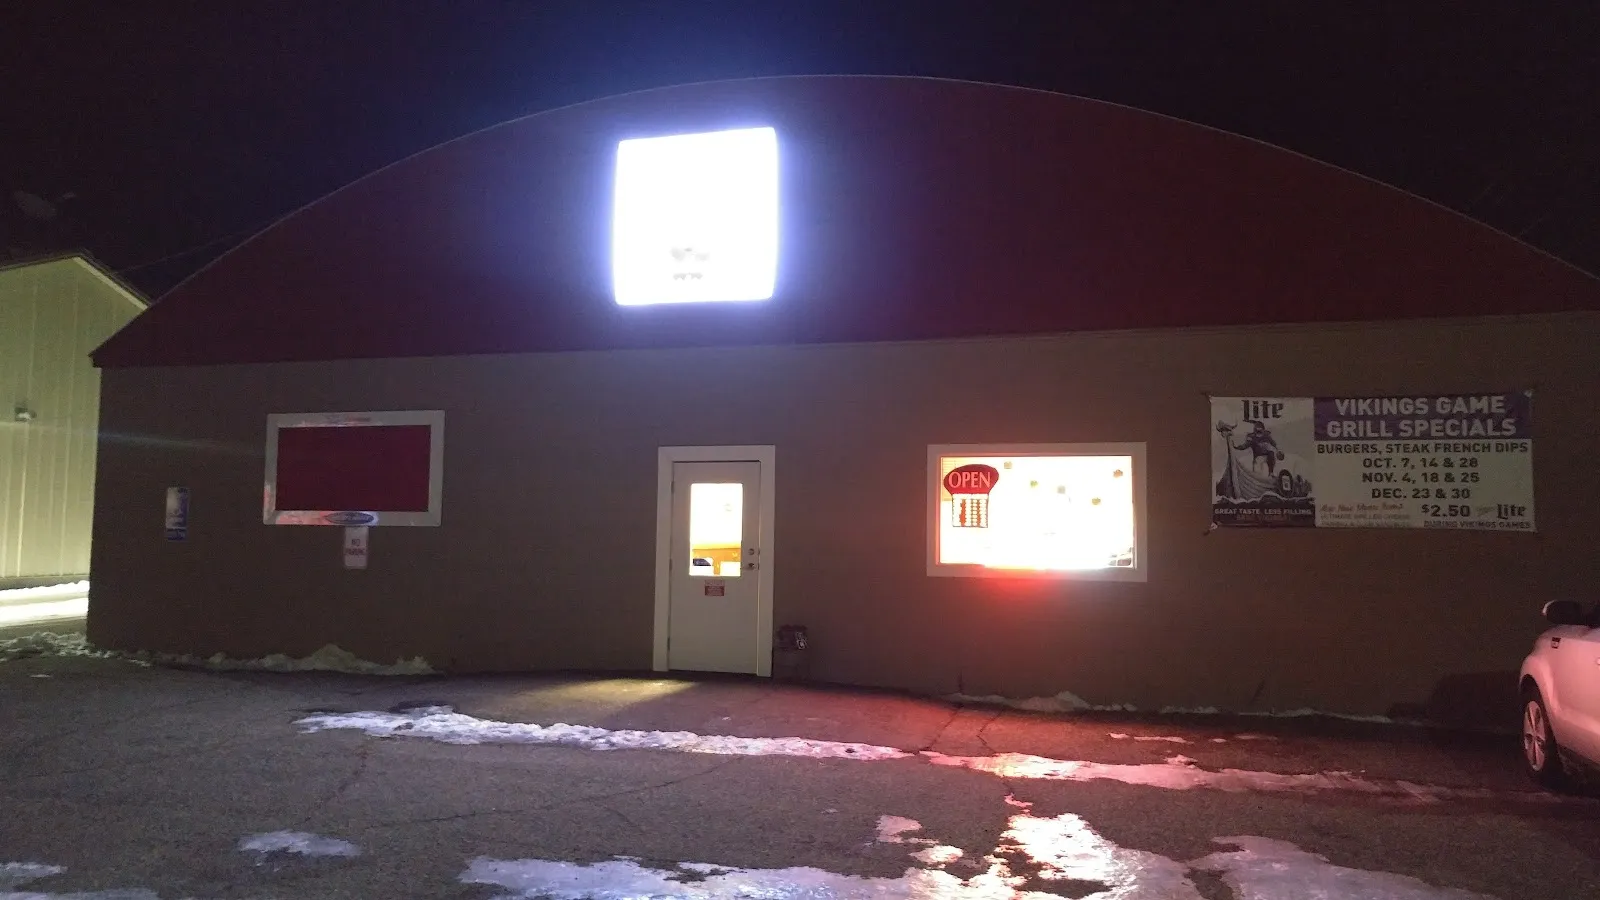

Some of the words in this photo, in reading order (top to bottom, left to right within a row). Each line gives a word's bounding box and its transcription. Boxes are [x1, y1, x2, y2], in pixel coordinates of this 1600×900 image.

[1241, 400, 1284, 422] Lite
[1335, 398, 1429, 416] VIKINGS
[1436, 396, 1506, 414] GAME
[1326, 421, 1393, 438] GRILL
[1399, 418, 1517, 438] SPECIALS
[1317, 443, 1383, 455] BURGERS,
[1385, 443, 1430, 454] STEAK
[1434, 442, 1491, 453] FRENCH
[1495, 442, 1529, 453] DIPS
[1362, 457, 1397, 468] OCT.
[1401, 457, 1415, 470] 7,
[1420, 457, 1438, 468] 14
[1443, 457, 1454, 468] &
[1459, 457, 1479, 468] 28
[948, 471, 991, 488] OPEN
[1362, 472, 1397, 483] NOV.
[1402, 472, 1416, 484] 4,
[1420, 472, 1439, 483] 18
[1444, 472, 1455, 483] &
[1460, 472, 1480, 483] 25
[1371, 488, 1407, 499] DEC.
[1411, 488, 1430, 499] 23
[1435, 488, 1446, 499] &
[1451, 488, 1471, 499] 30
[1214, 508, 1237, 516] GREAT
[1264, 508, 1283, 516] LESS
[1283, 508, 1312, 516] FILLING
[1421, 504, 1470, 517] $2.50
[1497, 504, 1527, 519] Lite
[1499, 521, 1531, 529] GAMES
